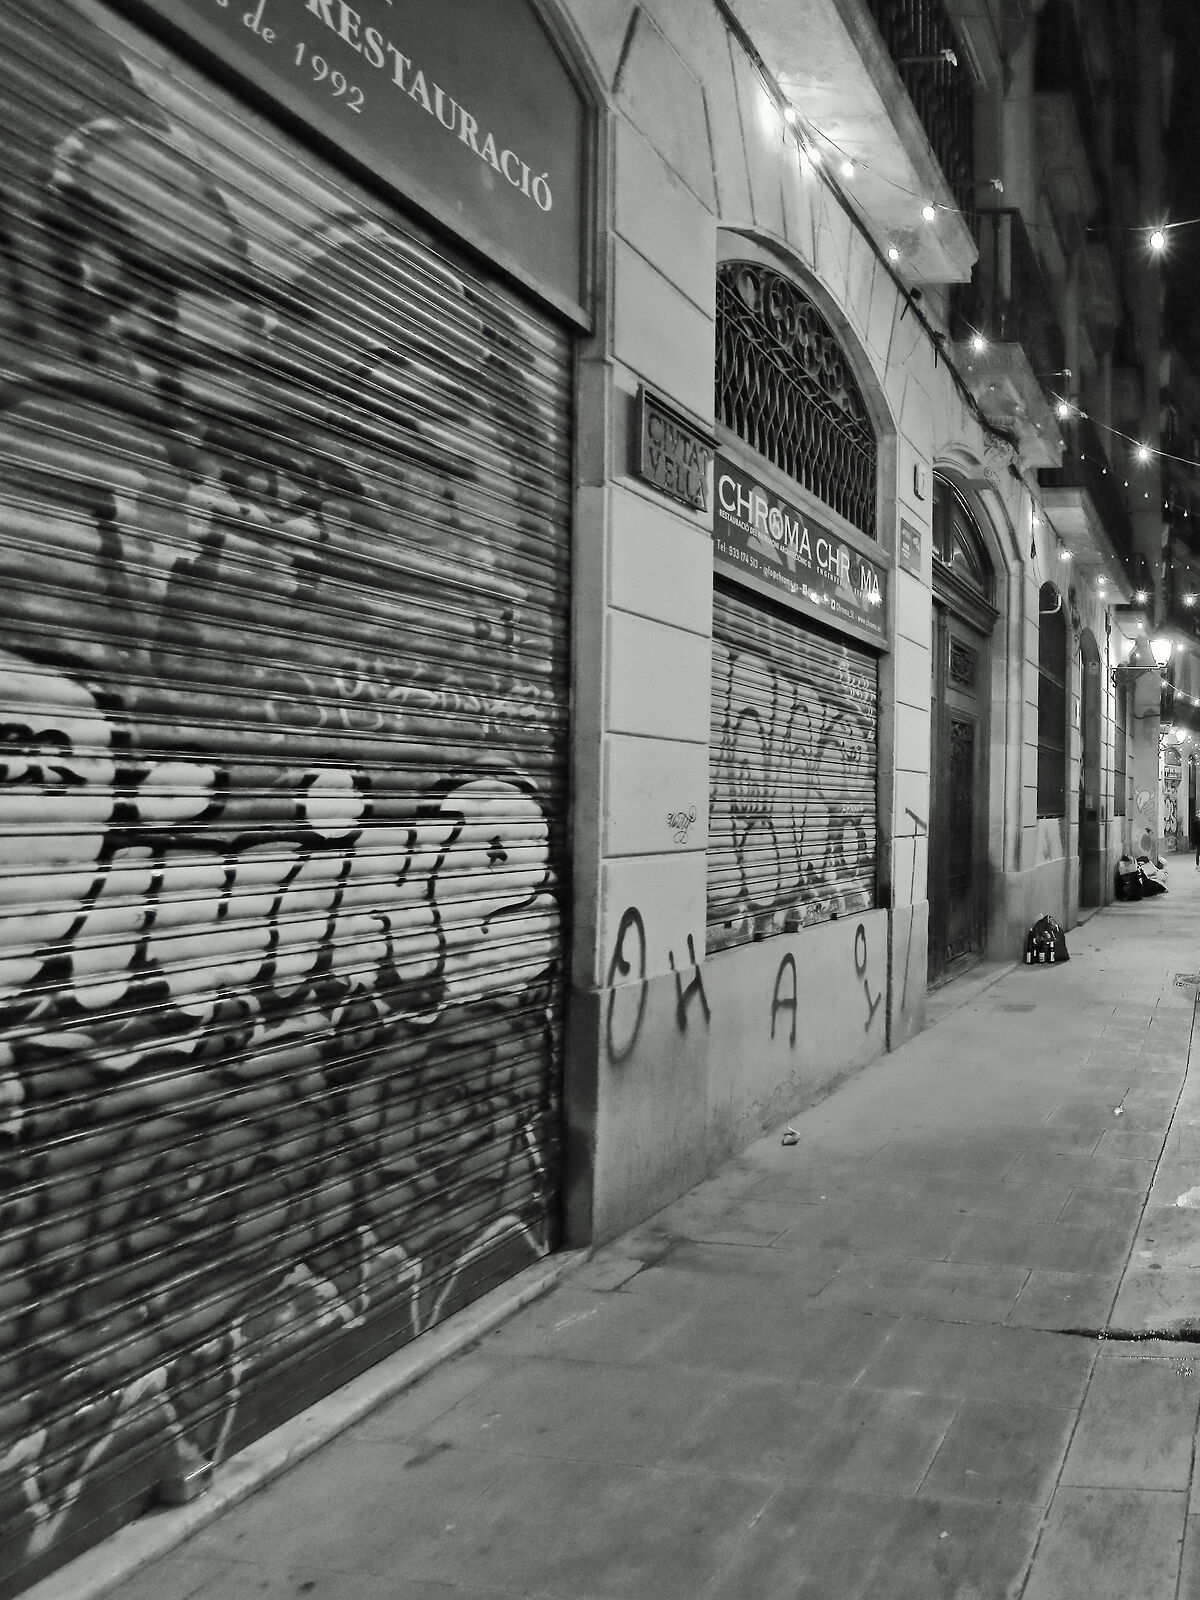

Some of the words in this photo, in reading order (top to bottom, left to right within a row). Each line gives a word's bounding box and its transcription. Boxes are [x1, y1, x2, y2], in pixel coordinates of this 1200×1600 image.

[295, 42, 365, 114] 1992
[305, 0, 553, 212] RESTAURACIÓ
[718, 474, 812, 561] CHROMA
